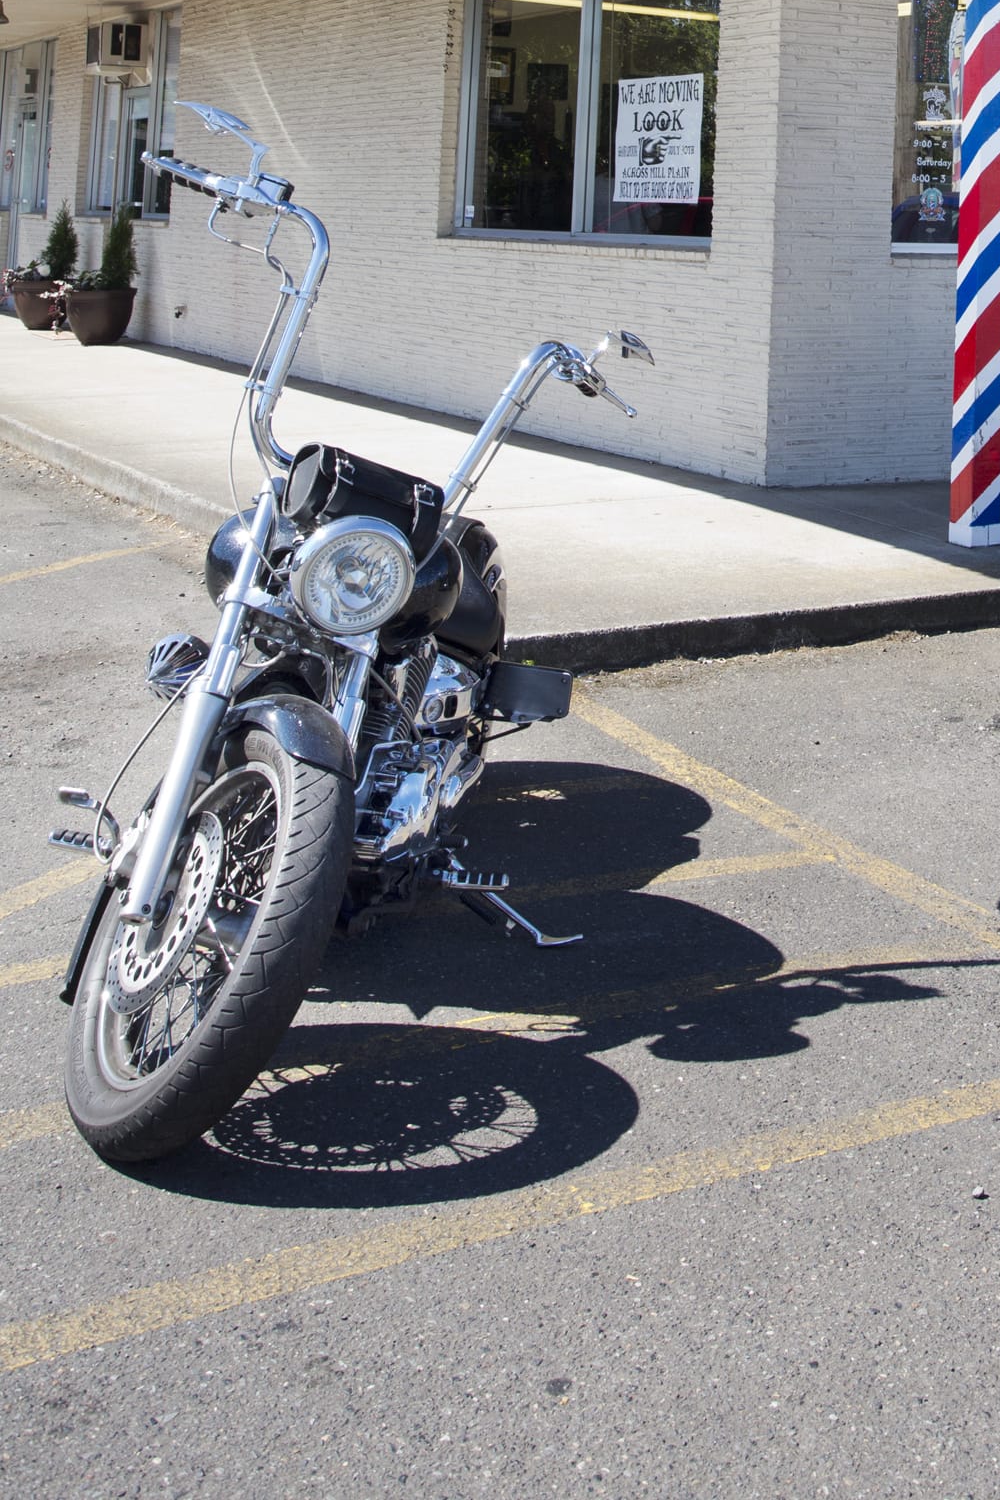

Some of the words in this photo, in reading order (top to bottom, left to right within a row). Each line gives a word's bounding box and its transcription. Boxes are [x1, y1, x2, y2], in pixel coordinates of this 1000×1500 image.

[621, 84, 636, 105] WE
[638, 82, 657, 105] ARE
[659, 79, 700, 103] MOVING
[633, 108, 685, 132] LOOK
[913, 140, 932, 148] 9:00
[917, 156, 952, 170] Saturday
[622, 167, 649, 179] ACROSS
[650, 167, 666, 179] MILL
[667, 166, 690, 179] PLAIN
